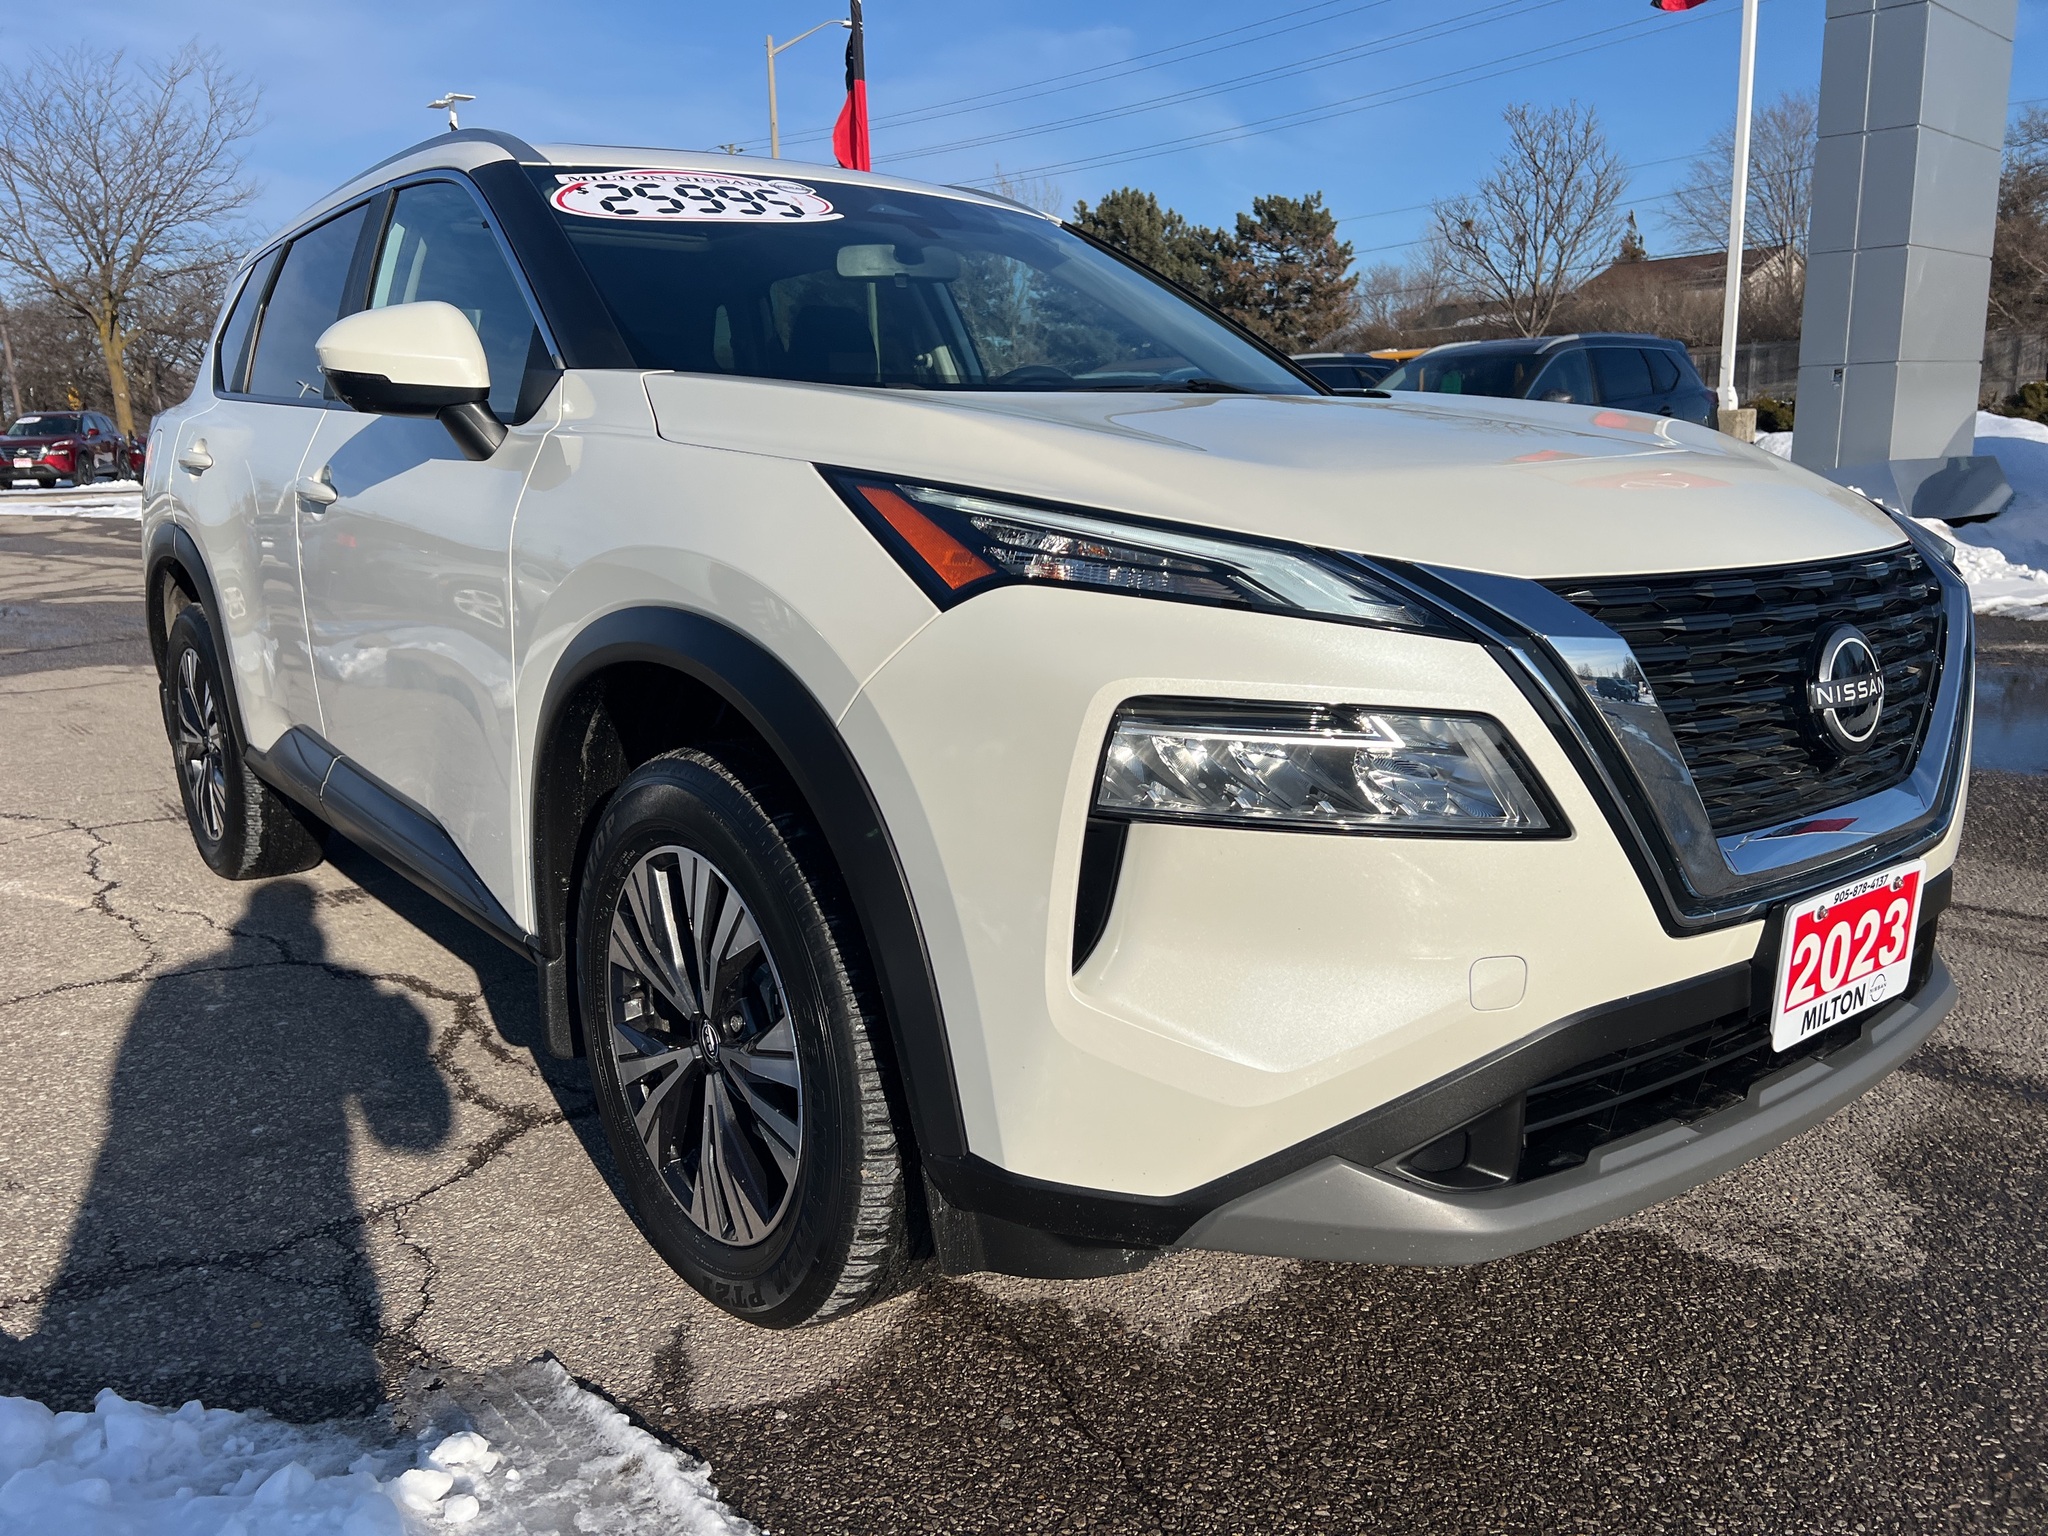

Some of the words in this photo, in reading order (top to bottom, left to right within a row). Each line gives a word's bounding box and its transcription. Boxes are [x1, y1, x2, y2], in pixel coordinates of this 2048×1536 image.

[568, 174, 667, 182] MILTON
[675, 176, 763, 187] NISSAN
[1816, 675, 1885, 705] NISSAN
[1833, 874, 1890, 905] 905-878-4137
[1786, 897, 1909, 1010] 2023
[1801, 983, 1867, 1036] MILTON
